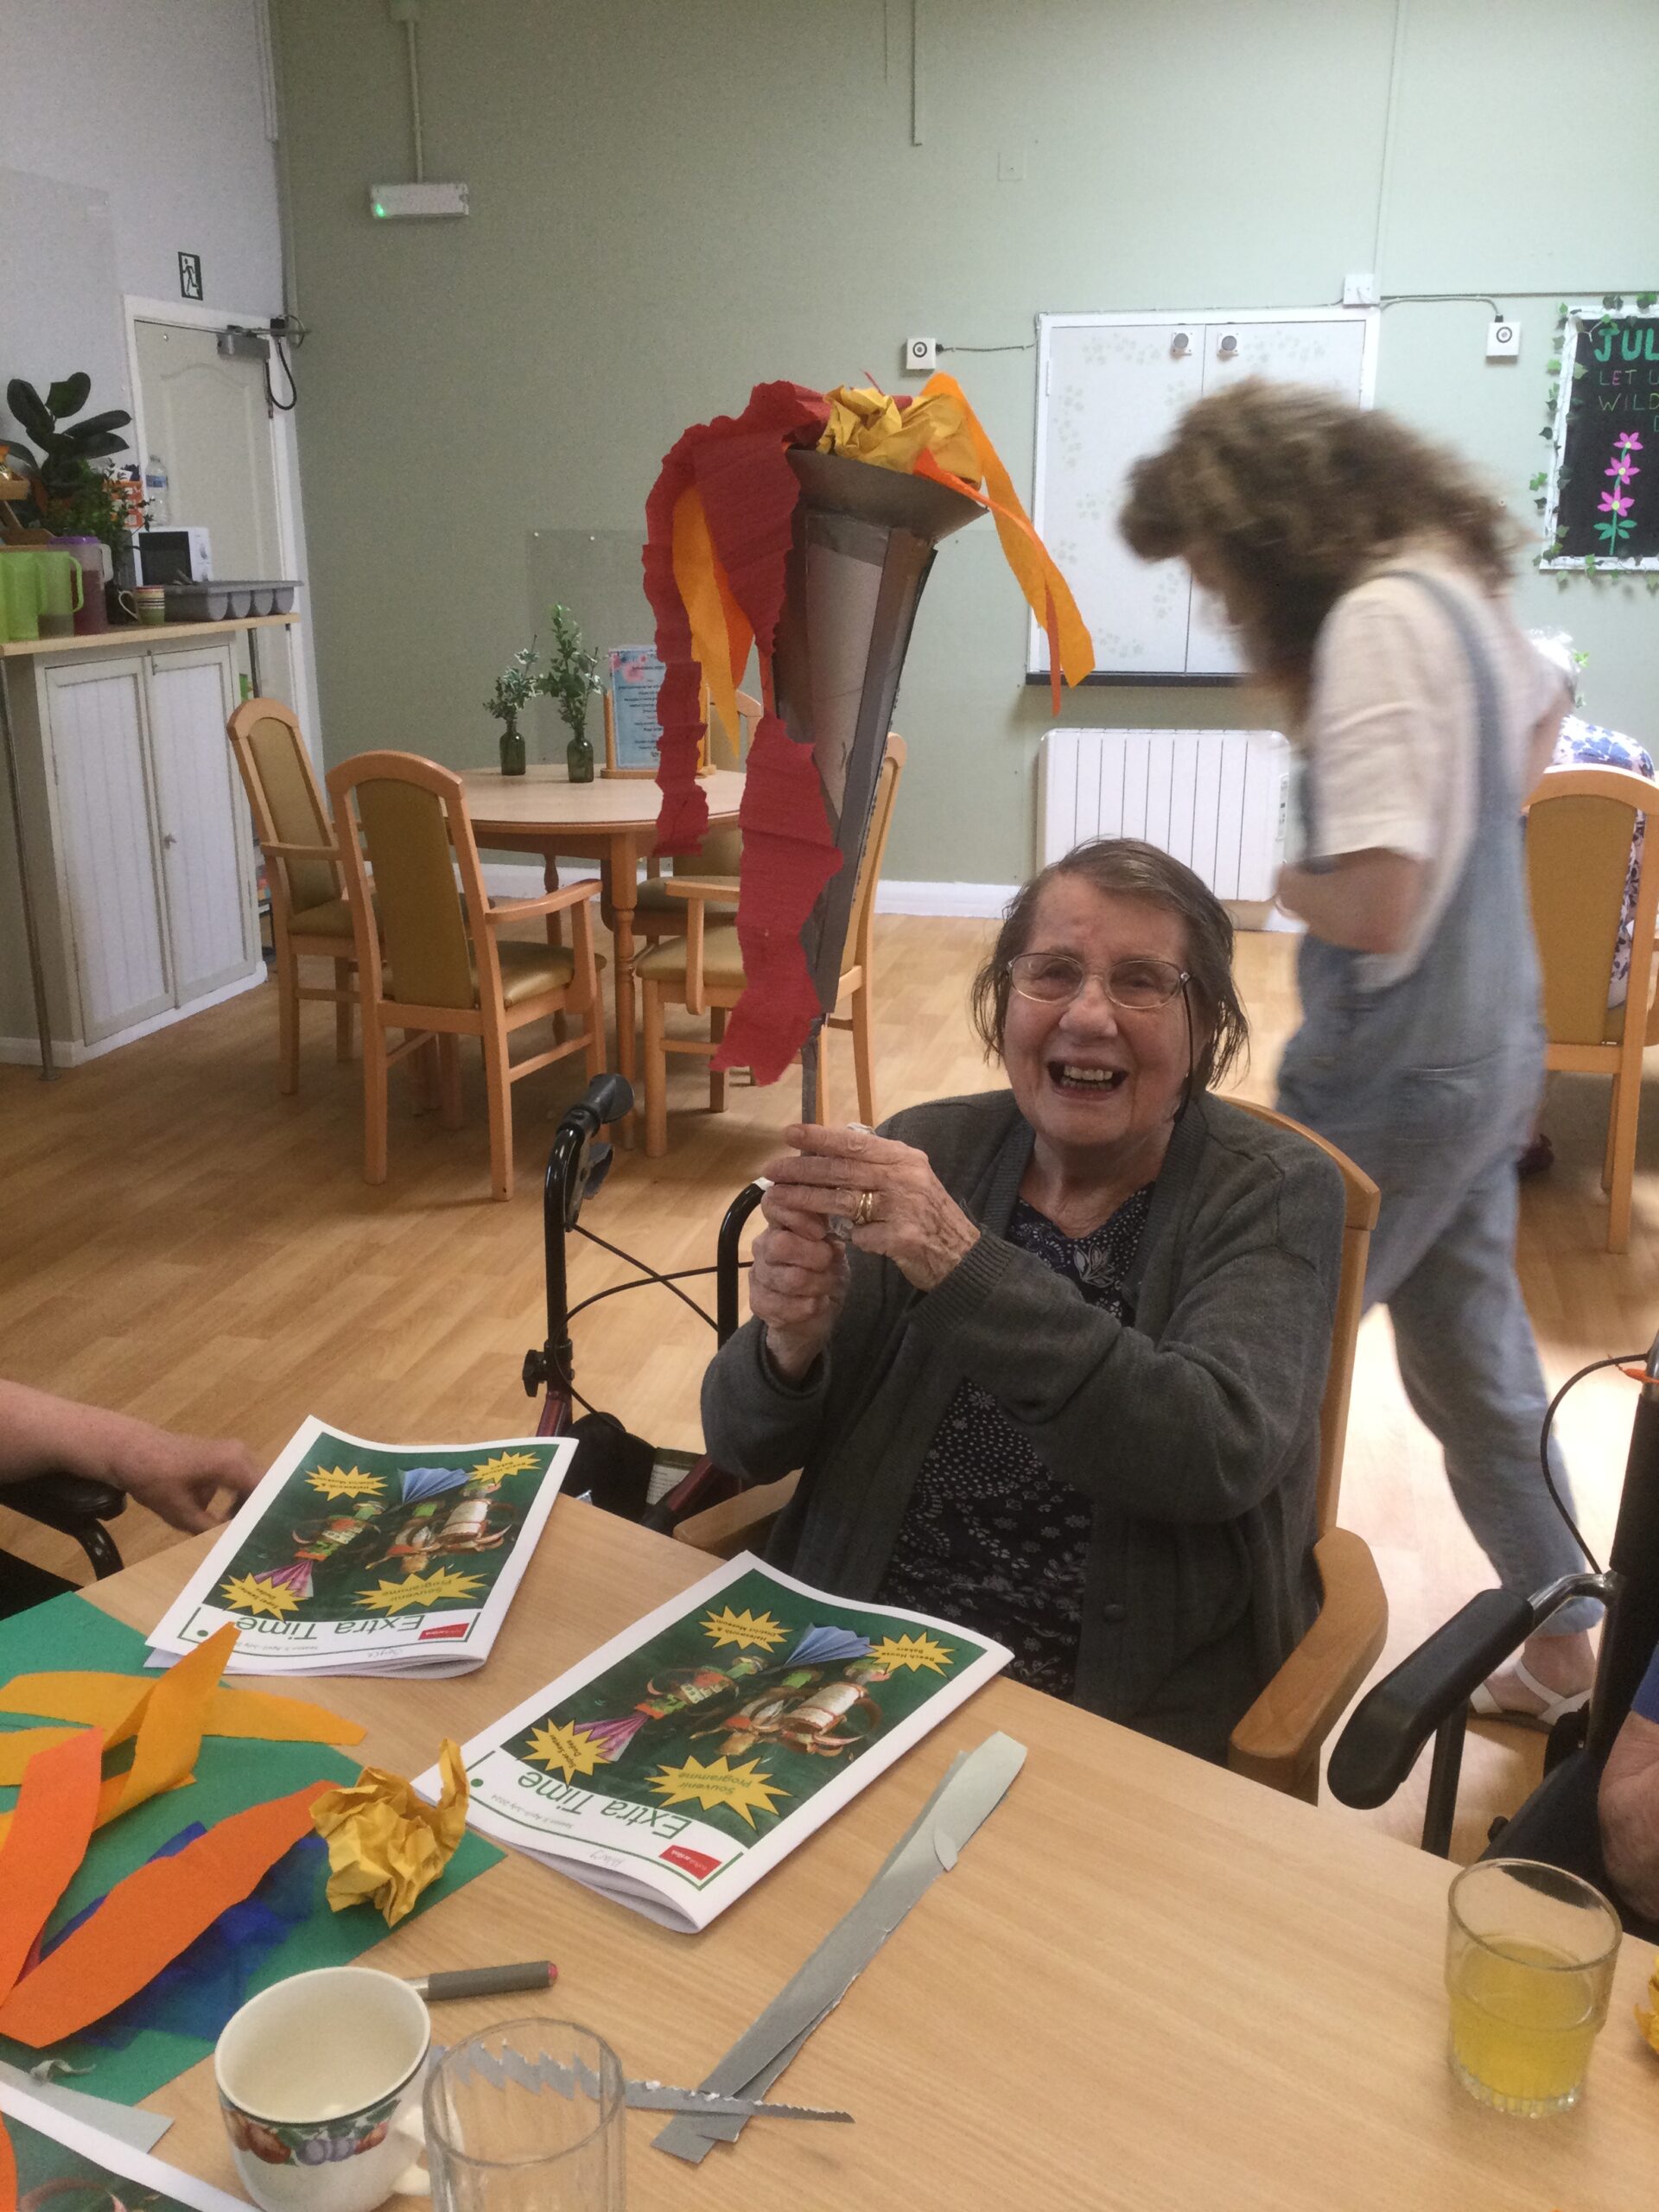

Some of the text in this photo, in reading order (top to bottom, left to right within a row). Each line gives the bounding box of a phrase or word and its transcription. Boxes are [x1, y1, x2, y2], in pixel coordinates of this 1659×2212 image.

[1599, 369, 1637, 385] LET
[381, 1580, 452, 1596] Programme
[389, 1586, 443, 1602] Souvenir
[236, 1617, 317, 1640] Time
[334, 1614, 425, 1635] Extra
[678, 1772, 753, 1788] Programme
[677, 1782, 736, 1795] Souvenir
[518, 1770, 692, 1840] Extra Time
